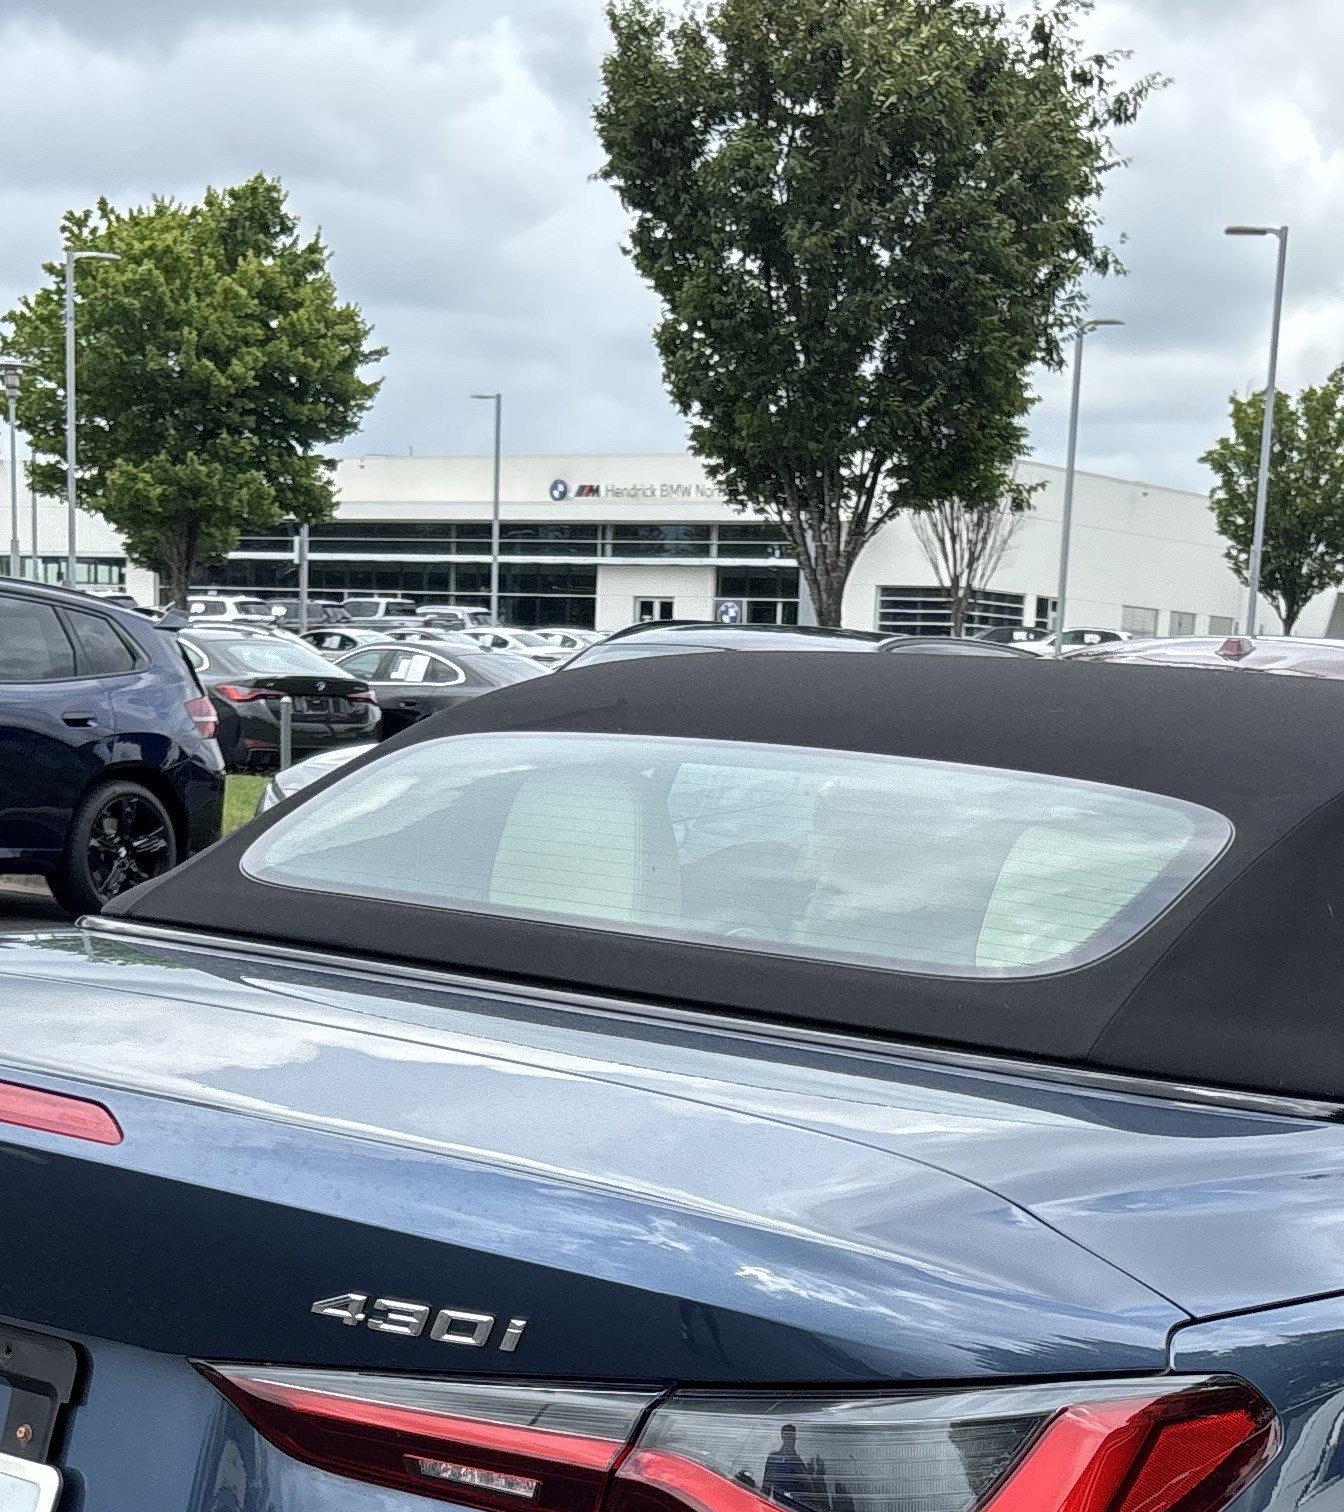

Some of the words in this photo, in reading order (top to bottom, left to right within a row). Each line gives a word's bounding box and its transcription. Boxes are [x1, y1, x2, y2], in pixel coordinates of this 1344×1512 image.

[605, 484, 657, 498] Hendrick
[660, 484, 693, 498] BMW
[311, 1293, 527, 1352] 430i
